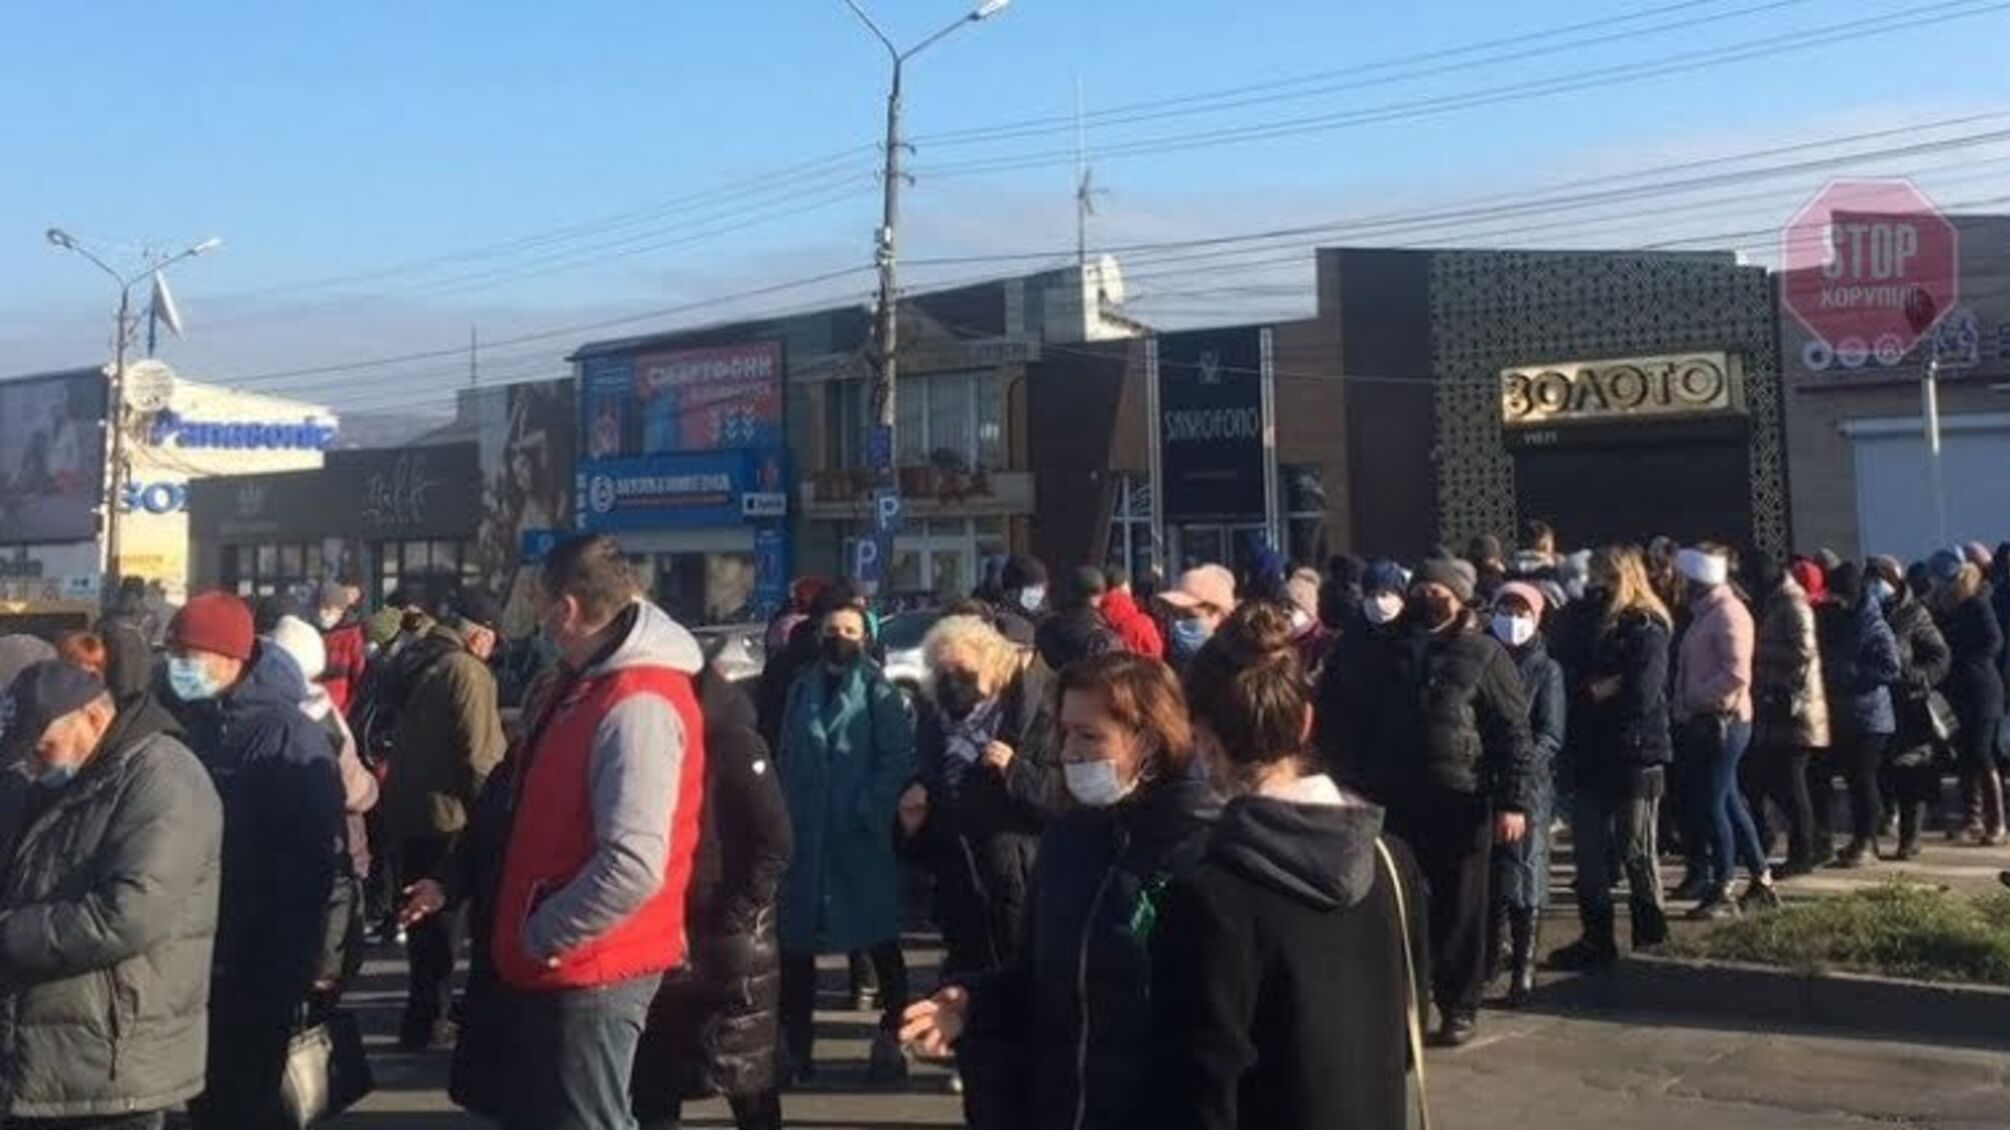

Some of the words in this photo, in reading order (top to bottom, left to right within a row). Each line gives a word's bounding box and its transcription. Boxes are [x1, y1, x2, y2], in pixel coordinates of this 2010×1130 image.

[1503, 359, 1723, 417] ЗОЛОТО
[148, 408, 337, 449] Panasonic
[879, 497, 899, 529] P
[857, 539, 878, 578] P
